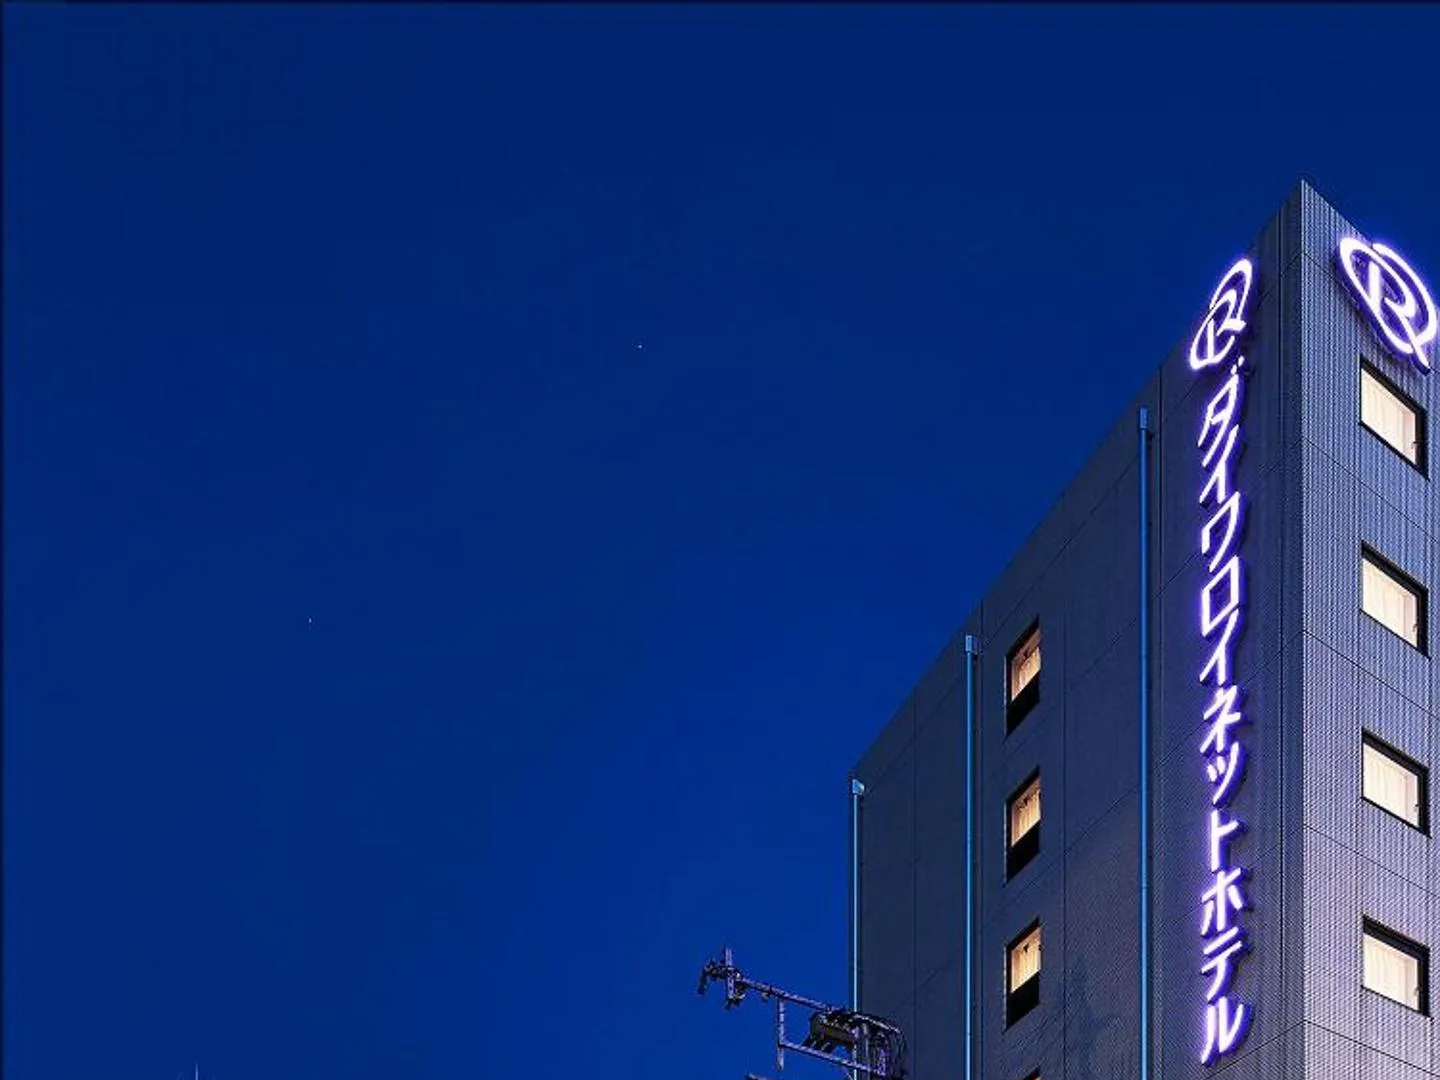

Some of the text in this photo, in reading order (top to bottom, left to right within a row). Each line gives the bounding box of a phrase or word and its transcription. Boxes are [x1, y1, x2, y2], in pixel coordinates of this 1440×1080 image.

[1196, 354, 1252, 1065] ダイワロイネットホテル
